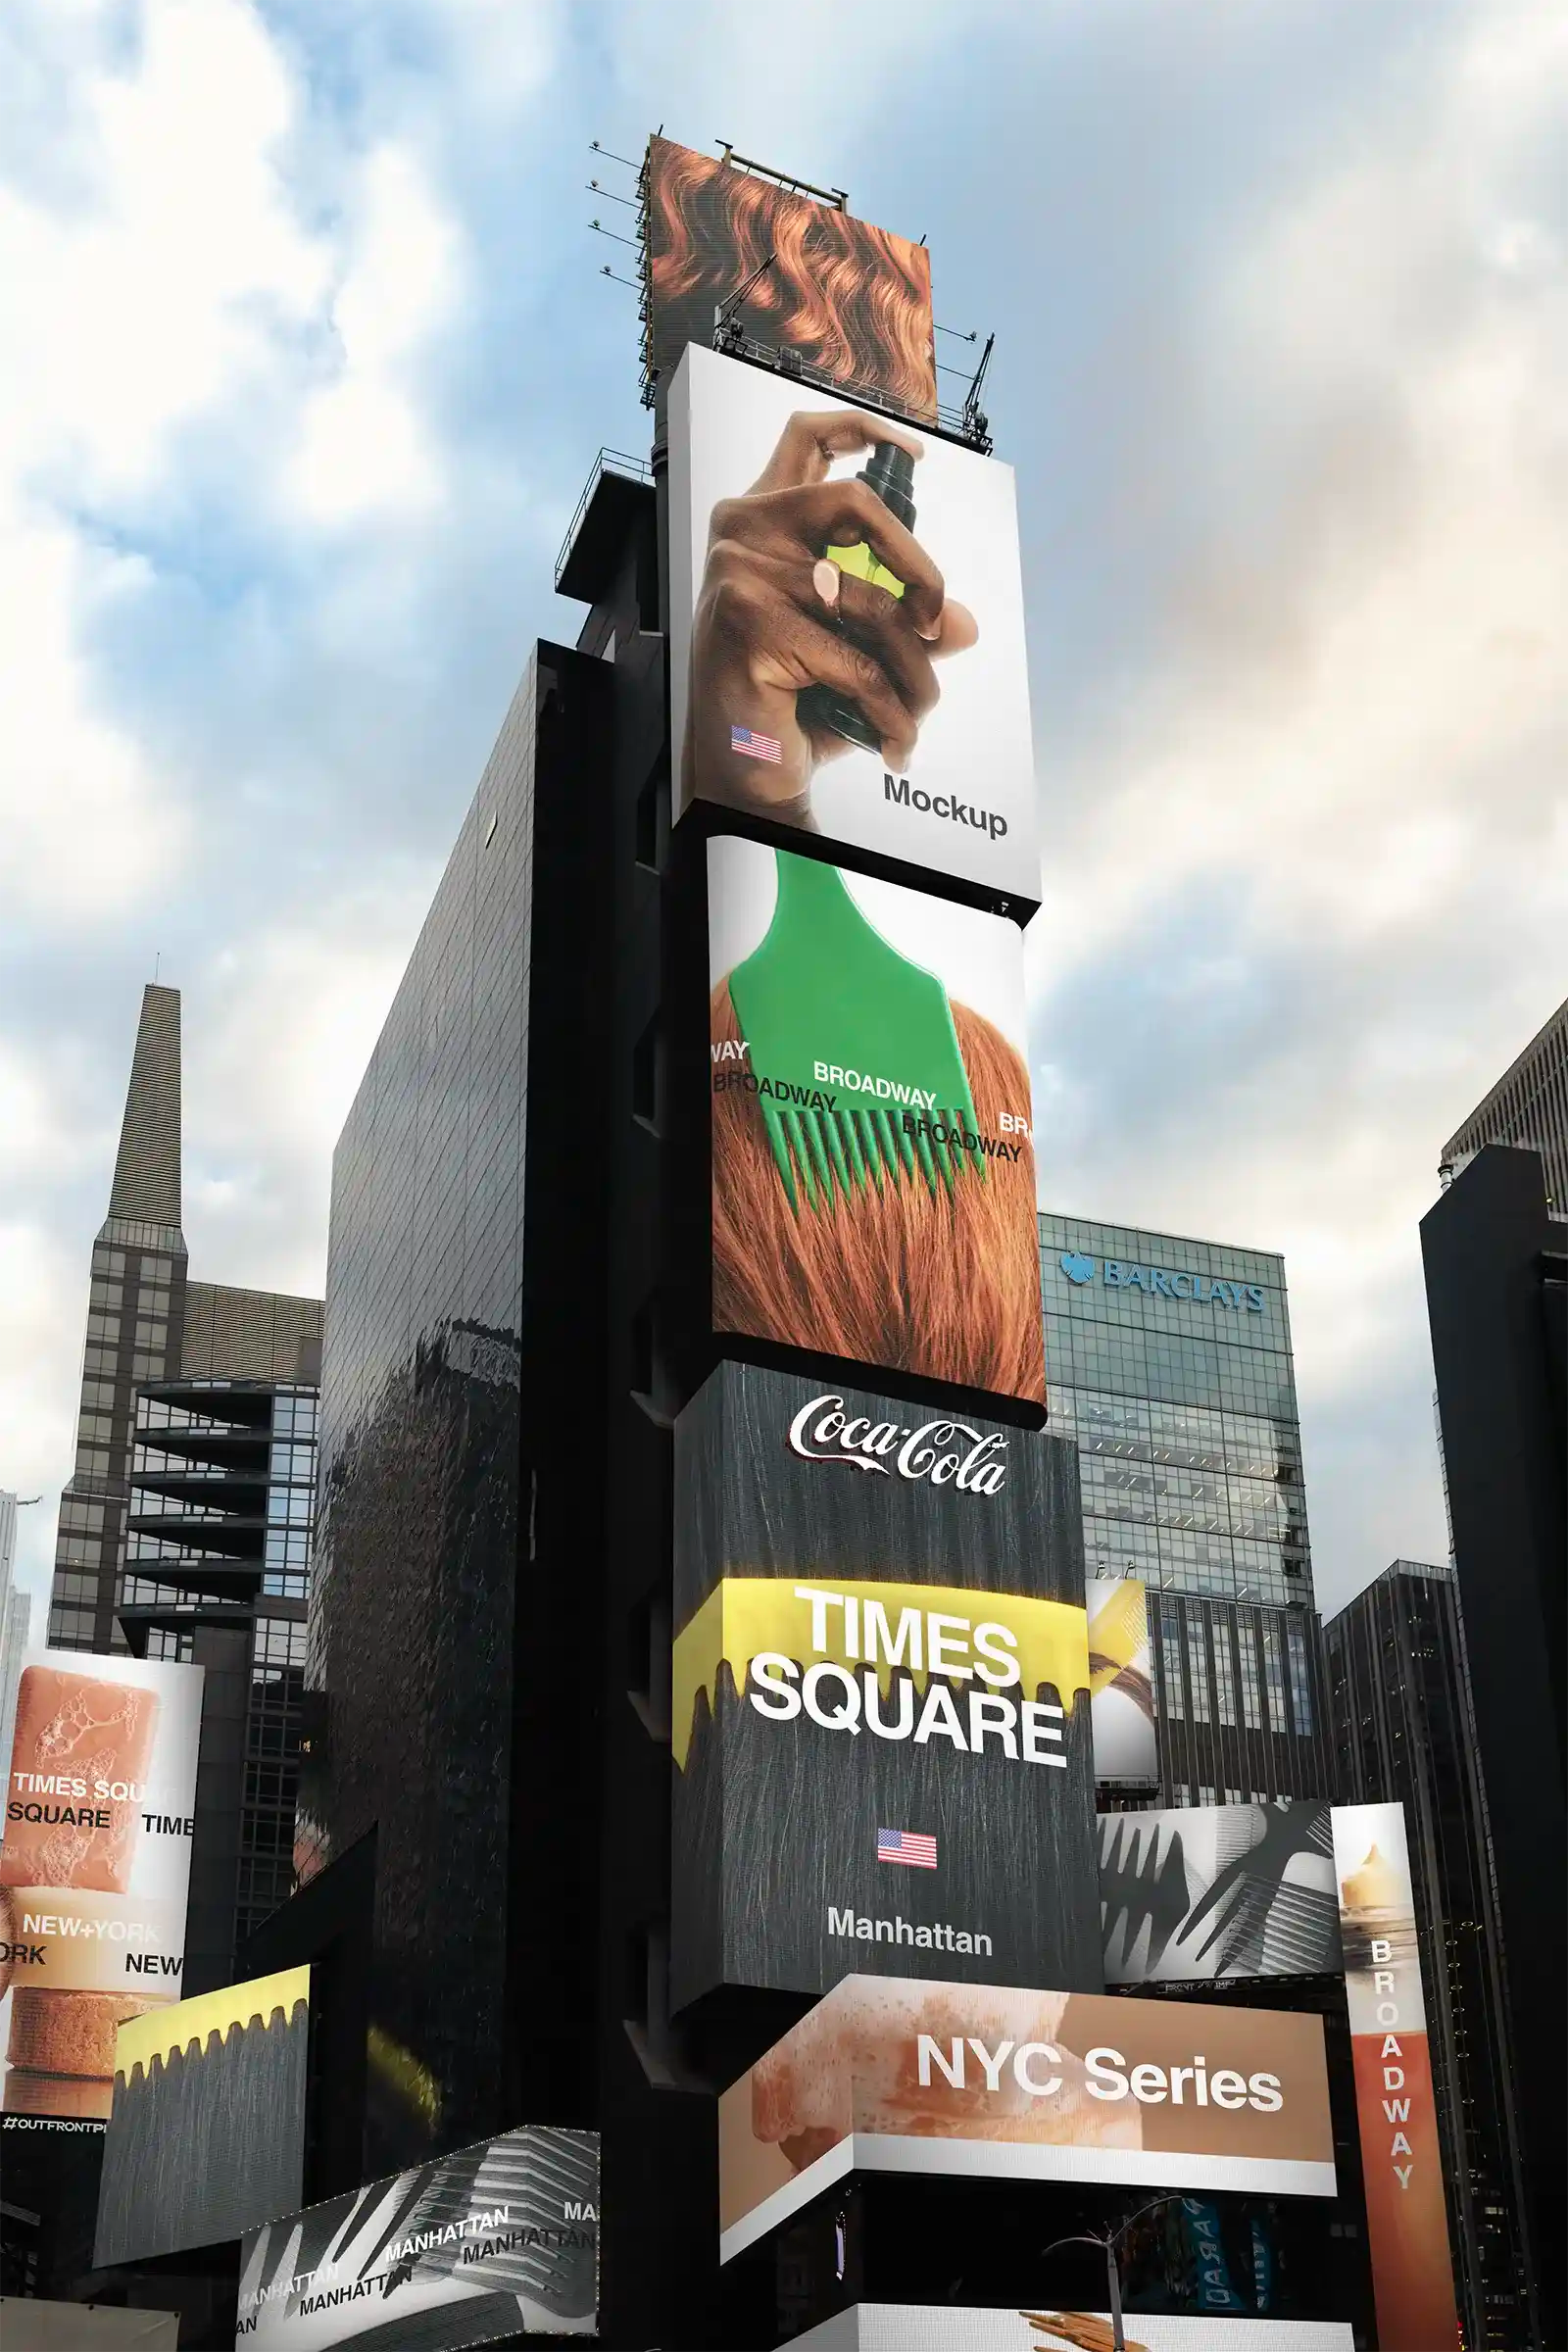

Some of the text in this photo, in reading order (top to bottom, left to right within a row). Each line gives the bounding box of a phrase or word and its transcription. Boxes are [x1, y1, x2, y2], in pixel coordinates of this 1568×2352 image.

[883, 773, 1008, 841] Mockup
[813, 1060, 937, 1110] BROADWAY
[713, 1073, 1023, 1163] BROADWAY BROADWAY
[1103, 1260, 1267, 1311] BARCLAYS
[794, 1586, 1021, 1689] TIMES
[749, 1651, 1068, 1769] SQUARE
[7, 1802, 111, 1829] SQUARE
[14, 1772, 87, 1797] TIMES
[827, 1907, 993, 1957] Manhattan
[125, 1953, 183, 1977] NEW
[917, 2034, 1284, 2112] NYC Series
[1370, 1939, 1414, 2190] BROADWAY
[384, 2206, 510, 2262] MANHATTAN
[564, 2201, 597, 2222] MA
[299, 2266, 413, 2317] MANHATTAN
[463, 2228, 596, 2265] MANHATTAN
